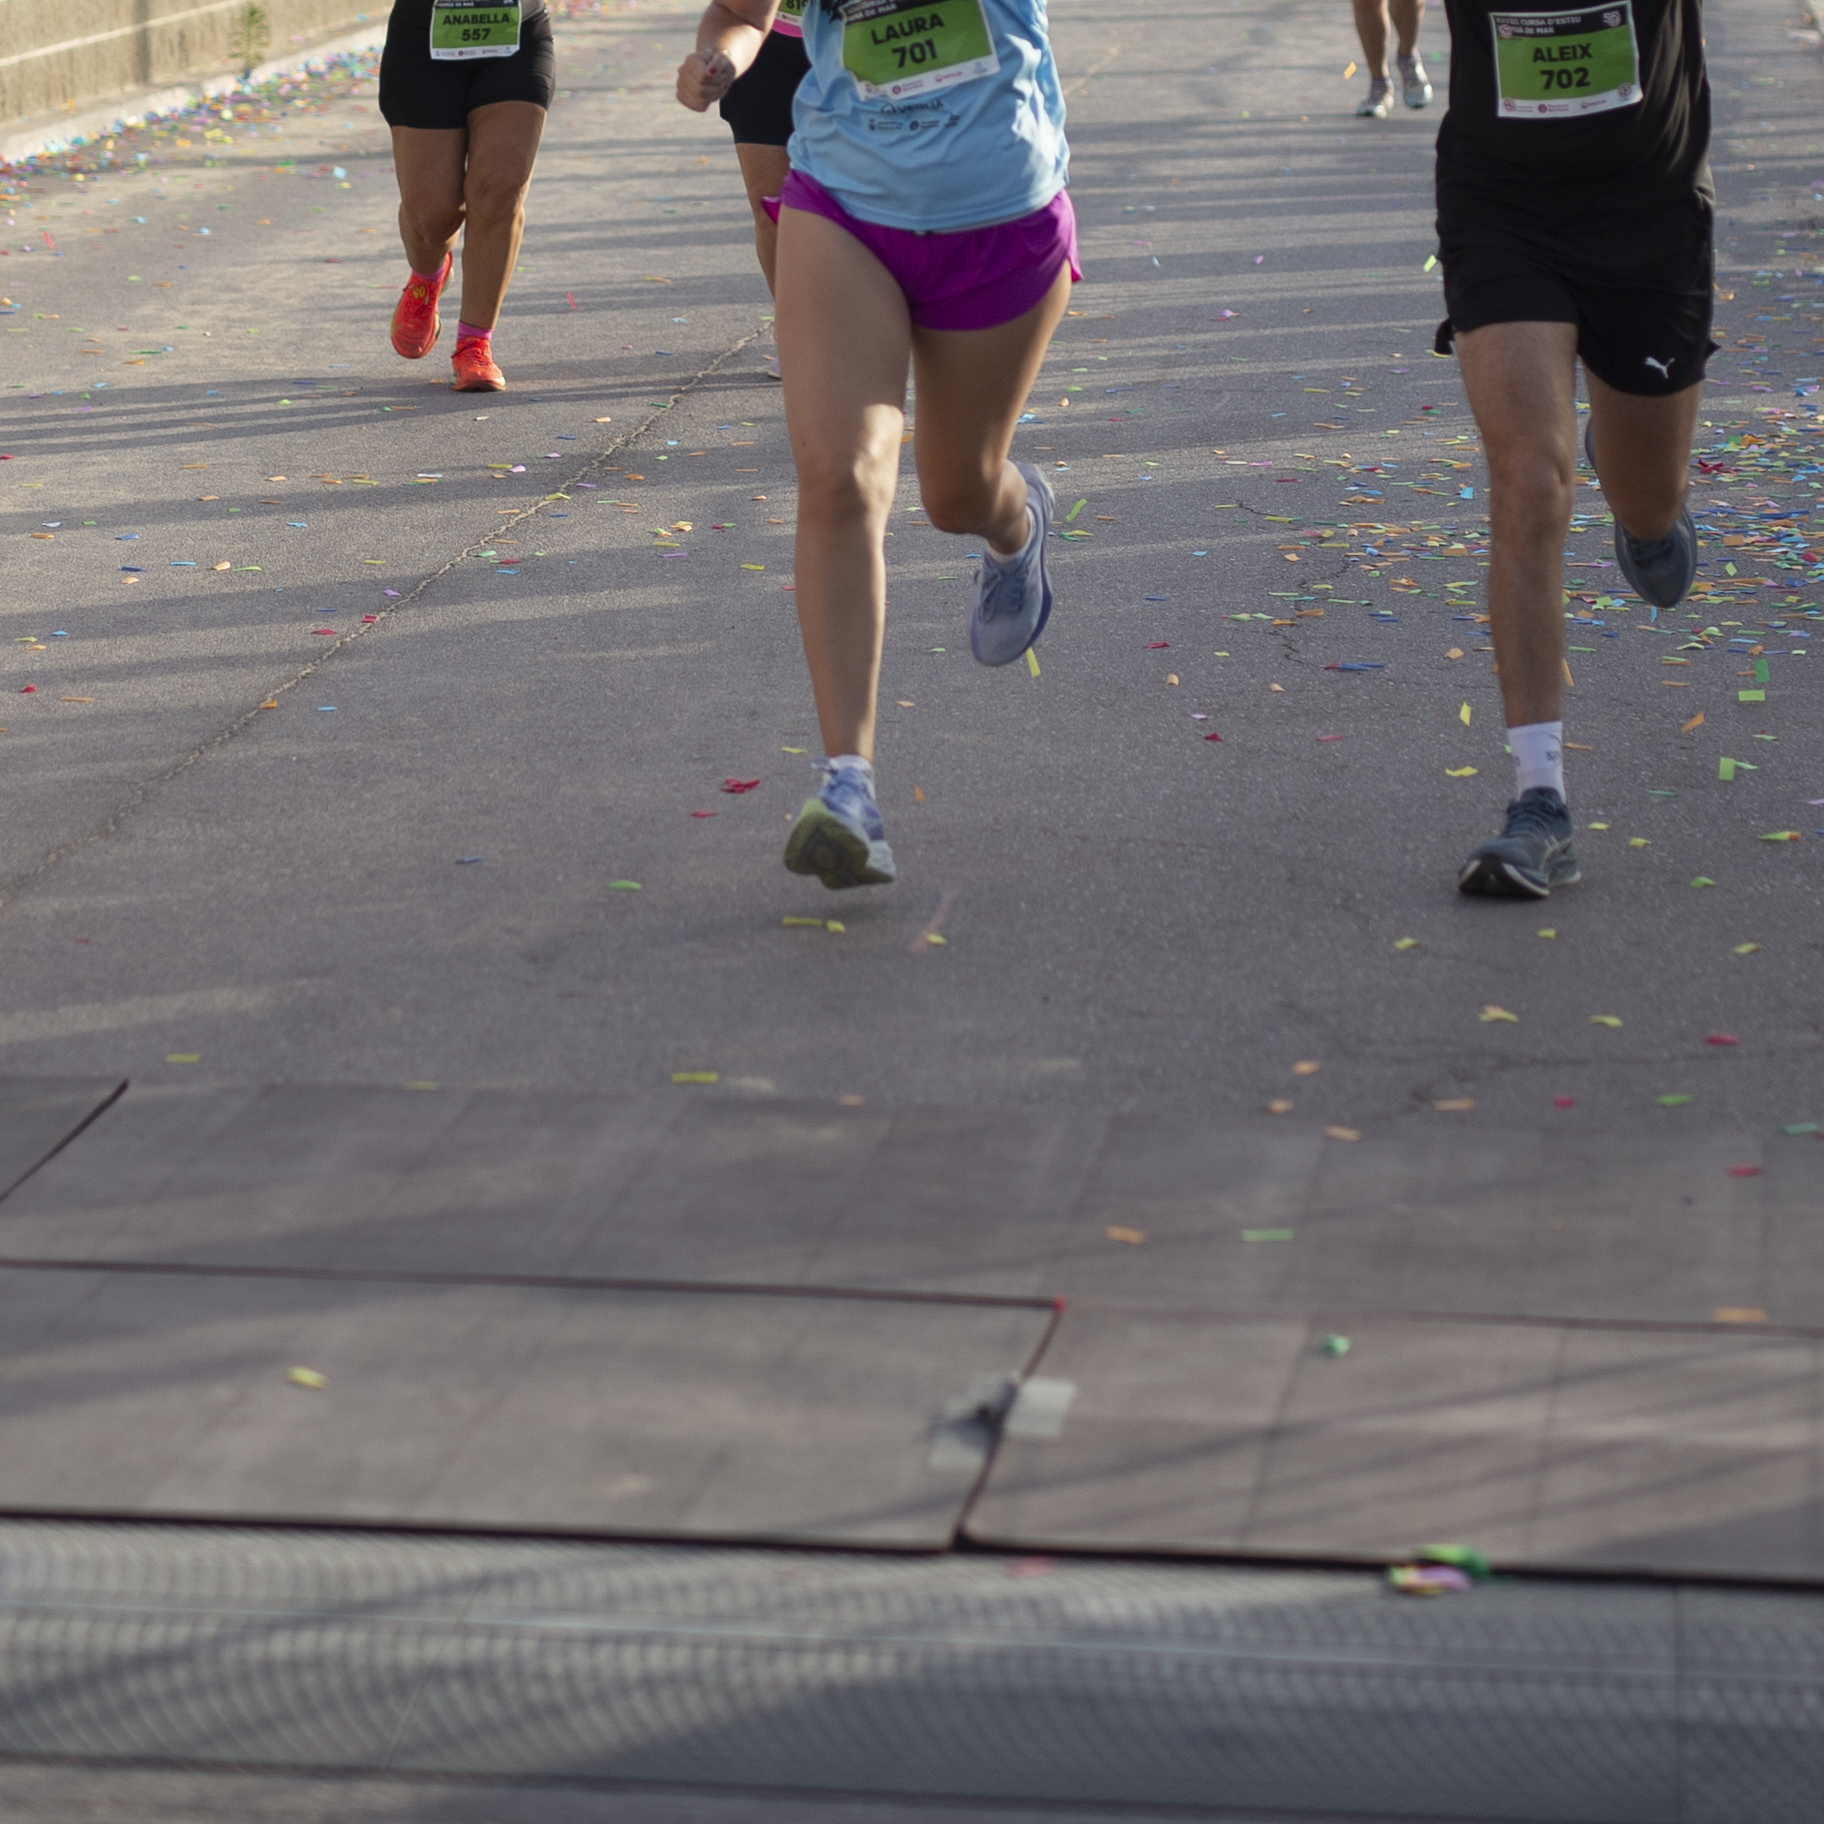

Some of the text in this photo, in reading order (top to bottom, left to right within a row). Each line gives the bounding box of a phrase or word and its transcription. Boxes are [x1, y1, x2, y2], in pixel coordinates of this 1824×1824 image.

[443, 13, 510, 25] ANABELLA
[871, 13, 945, 45] LAURA
[462, 28, 491, 41] 557
[892, 38, 938, 68] 701
[1533, 43, 1593, 63] ALEIX
[1540, 67, 1591, 90] 702
